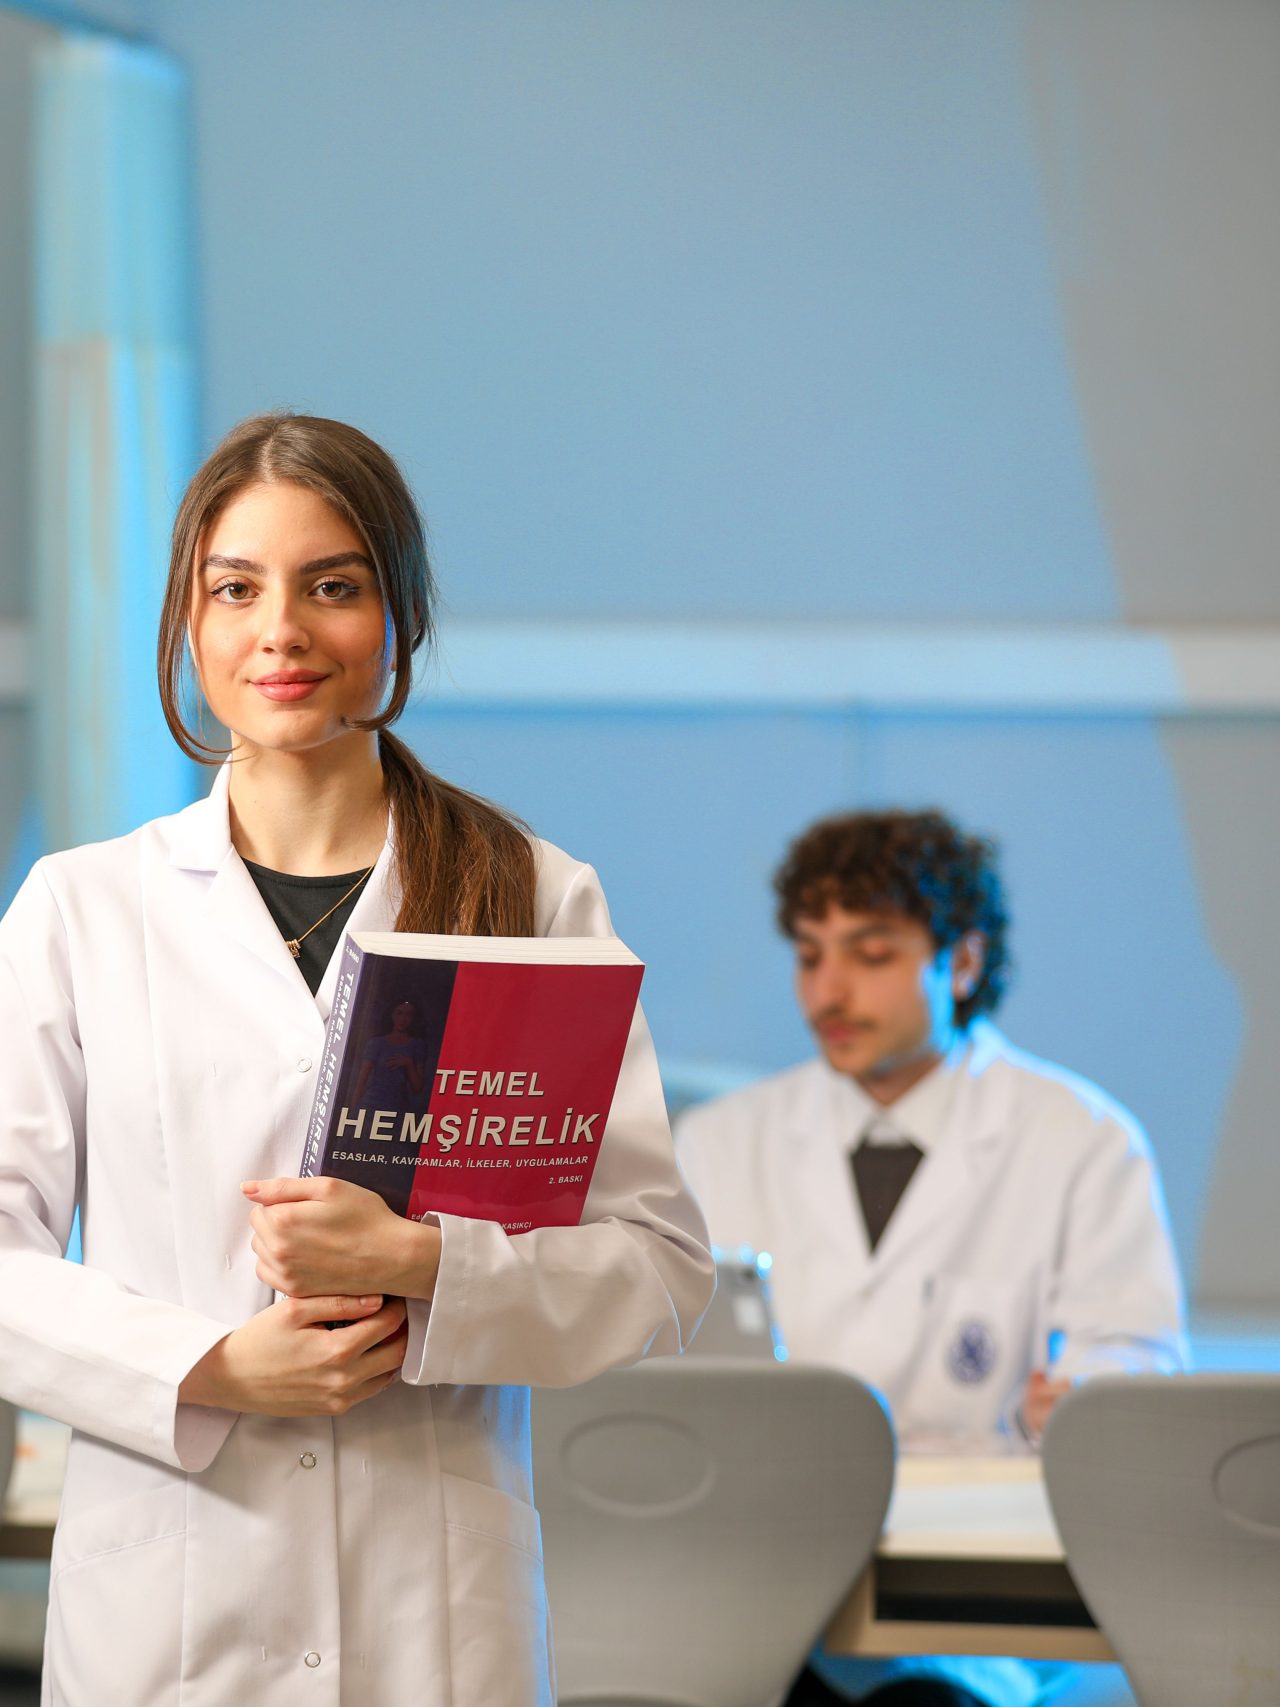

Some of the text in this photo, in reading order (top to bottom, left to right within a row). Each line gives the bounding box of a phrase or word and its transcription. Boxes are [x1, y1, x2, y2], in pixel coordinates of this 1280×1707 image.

[306, 973, 355, 1177] TEMEL HEMŞİRELİ
[436, 1069, 545, 1096] TEMEL
[336, 1107, 601, 1153] HEMŞİRELİK
[332, 1150, 589, 1169] ESASLAR, KAVRAMLAR, İLKELER, UYGULAMALAR
[548, 1175, 583, 1185] 2. BASKI
